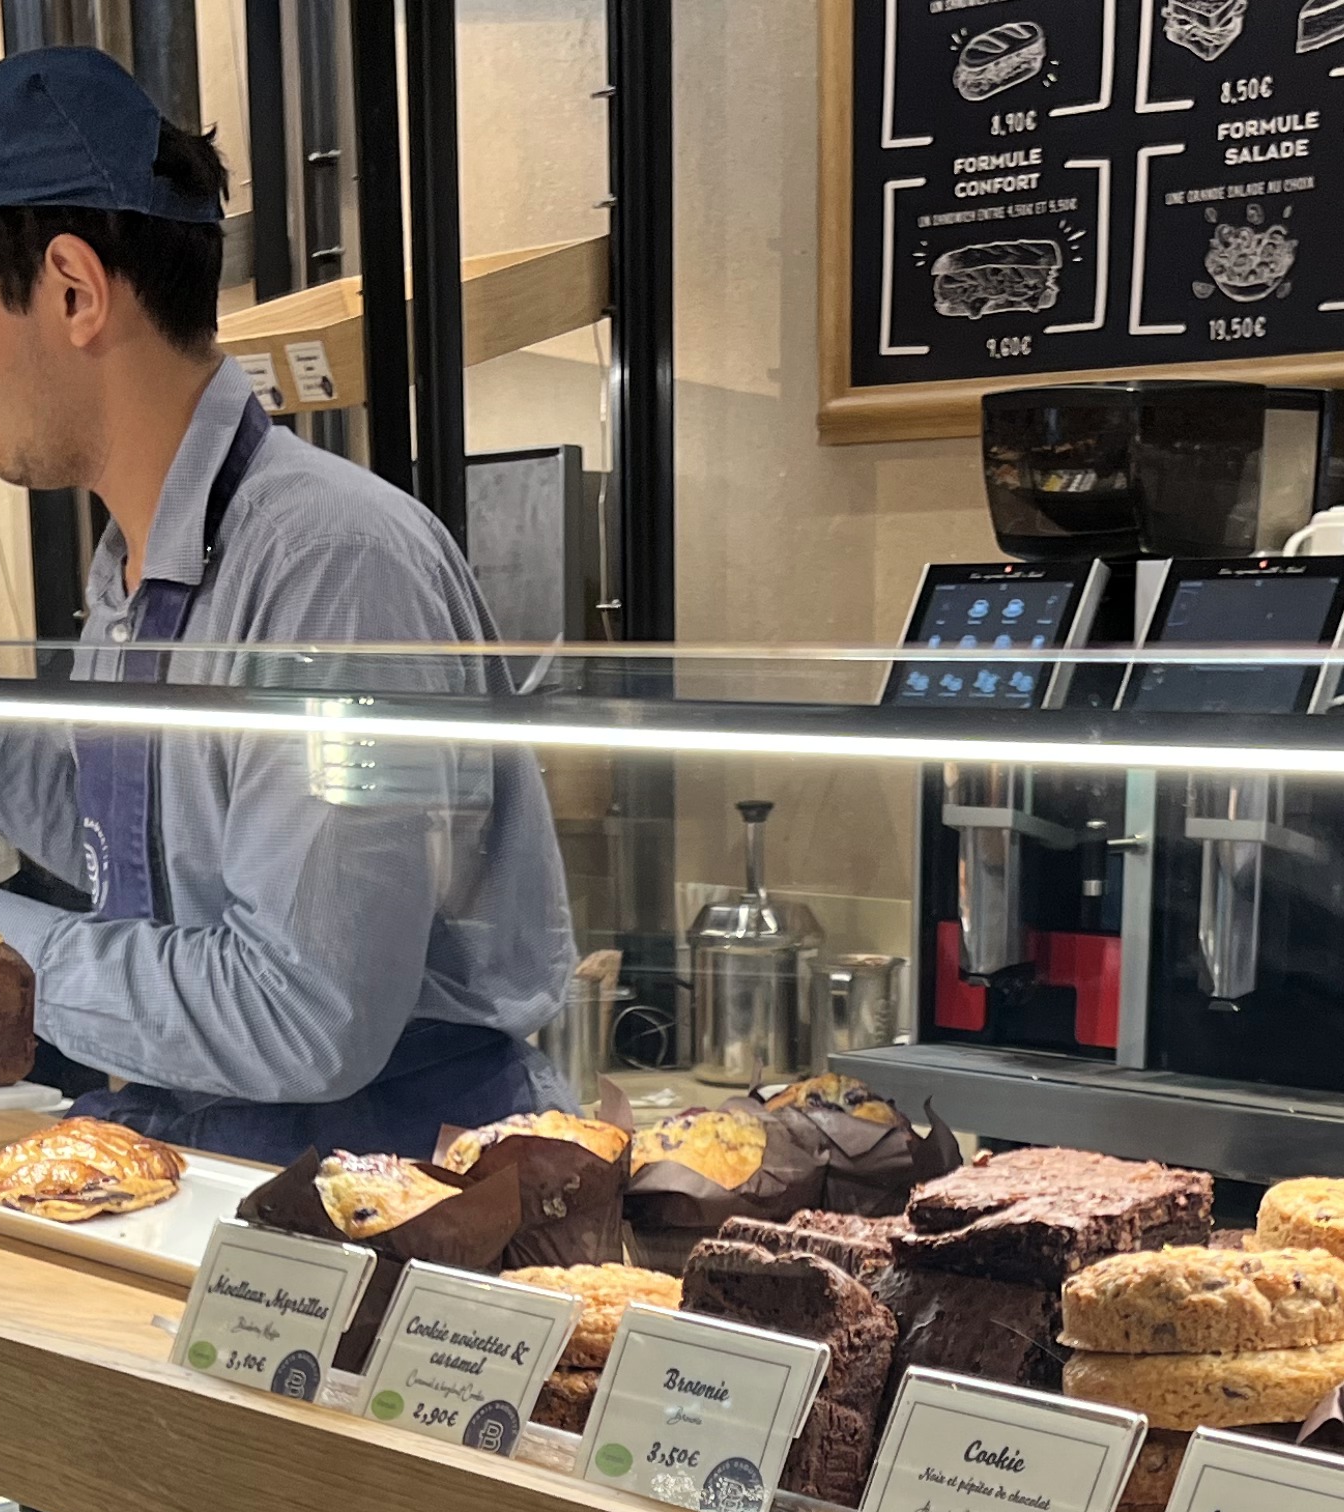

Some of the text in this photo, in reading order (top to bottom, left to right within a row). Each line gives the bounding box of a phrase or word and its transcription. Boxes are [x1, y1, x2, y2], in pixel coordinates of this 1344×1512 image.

[1220, 75, 1273, 104] 8.50€
[1217, 111, 1320, 141] FORMULE
[954, 148, 1042, 175] FORMULE
[1224, 139, 1309, 165] SALADE
[954, 173, 1041, 198] CONFORT
[208, 1274, 330, 1320] Moelleux Myrtilles
[406, 1315, 531, 1366] Cookie noisettes &
[226, 1350, 267, 1373] 3,10€
[429, 1351, 488, 1376] caramel
[662, 1367, 730, 1403] Brownie
[412, 1402, 460, 1428] 2,90€
[646, 1441, 701, 1469] 3,50€
[963, 1439, 1026, 1474] Cookie
[918, 1466, 1051, 1511] Noix et pépites de chocolat
